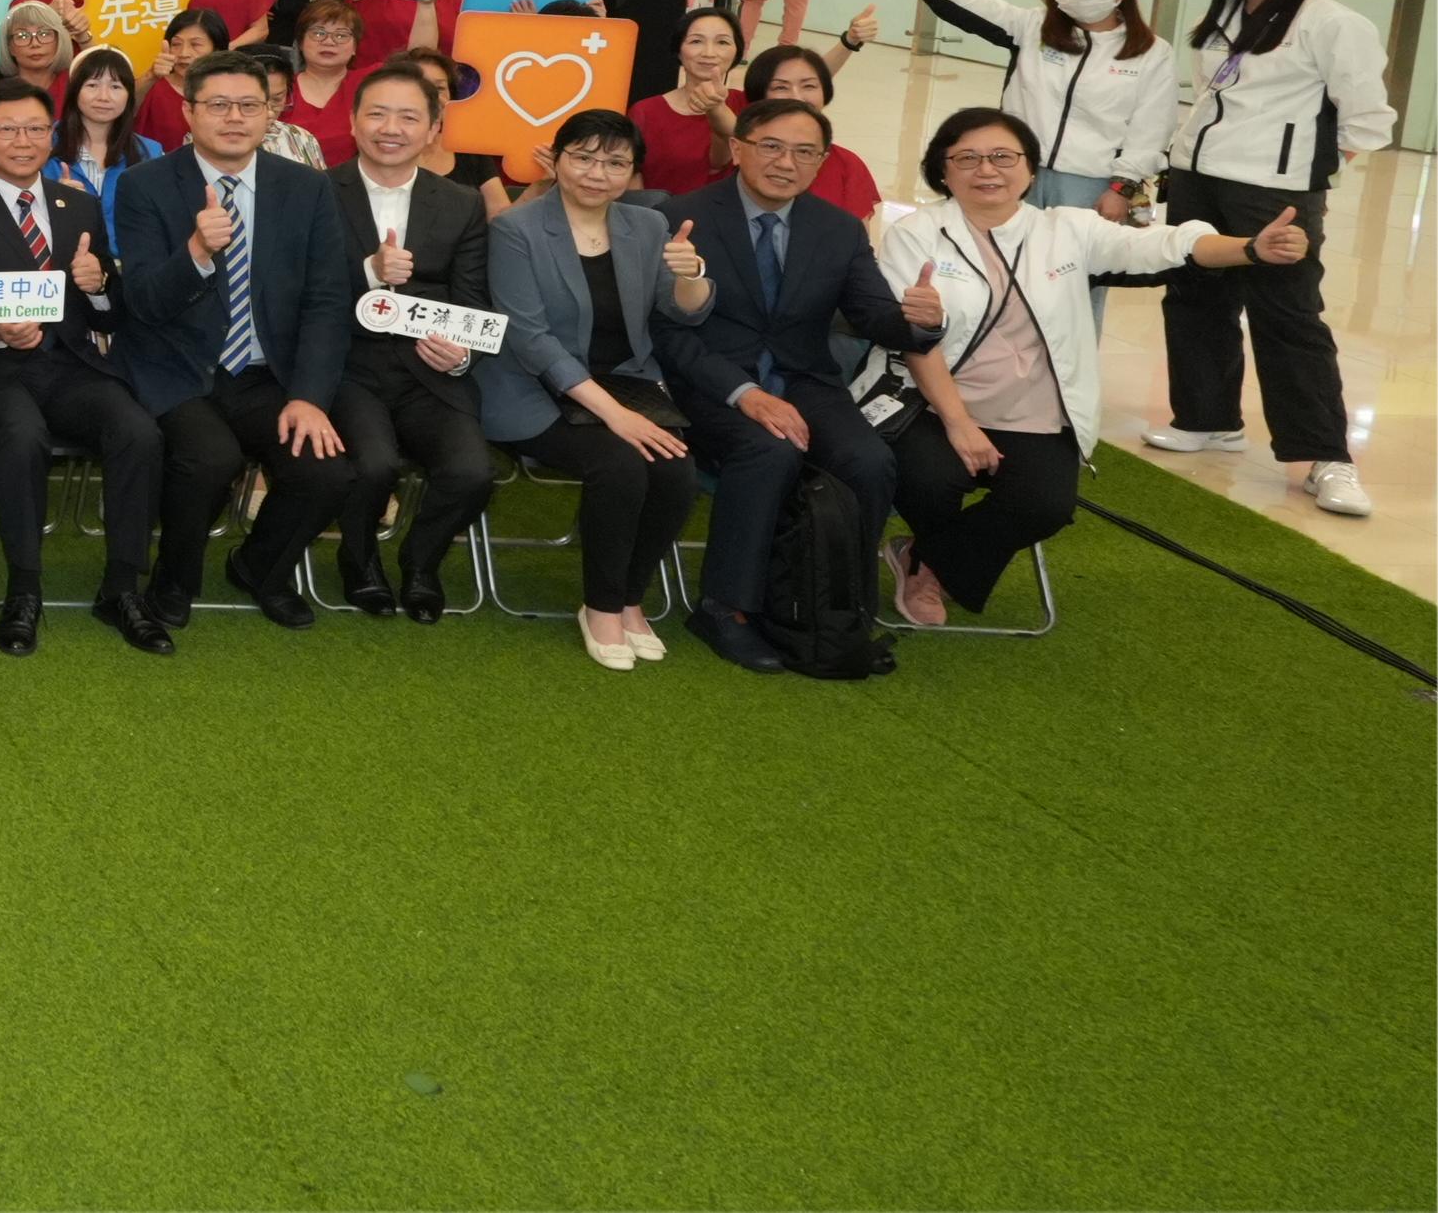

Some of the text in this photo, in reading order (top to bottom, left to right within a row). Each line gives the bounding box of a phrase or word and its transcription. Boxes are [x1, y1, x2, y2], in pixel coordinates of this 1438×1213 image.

[15, 304, 58, 317] Centre
[407, 301, 501, 339] 仁濟醫院
[403, 323, 422, 336] Yan
[451, 333, 497, 351] Hospital
